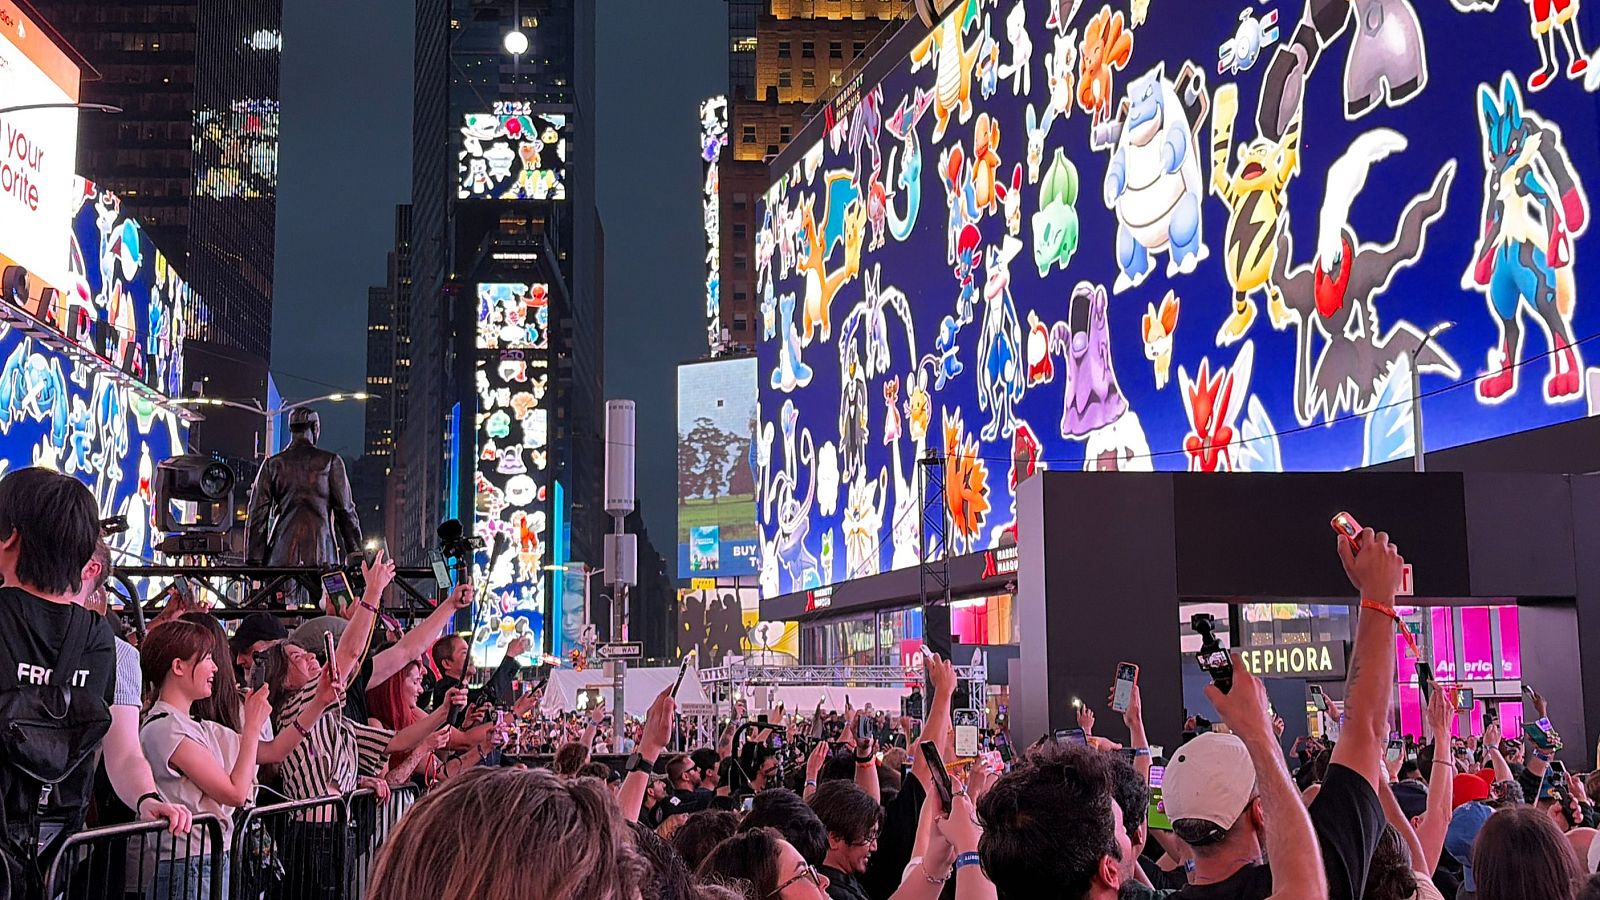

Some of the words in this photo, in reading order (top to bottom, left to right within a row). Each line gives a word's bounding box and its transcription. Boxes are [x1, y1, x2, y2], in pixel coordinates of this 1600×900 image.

[836, 73, 864, 108] MARRIOTT
[493, 101, 532, 115] 2026
[836, 91, 861, 122] MARQUIS
[7, 122, 44, 173] your
[0, 161, 39, 211] orite
[733, 545, 757, 557] BUY
[1241, 646, 1333, 674] SEPHORA
[1436, 660, 1513, 673] Aeric's
[17, 662, 90, 687] FRT
